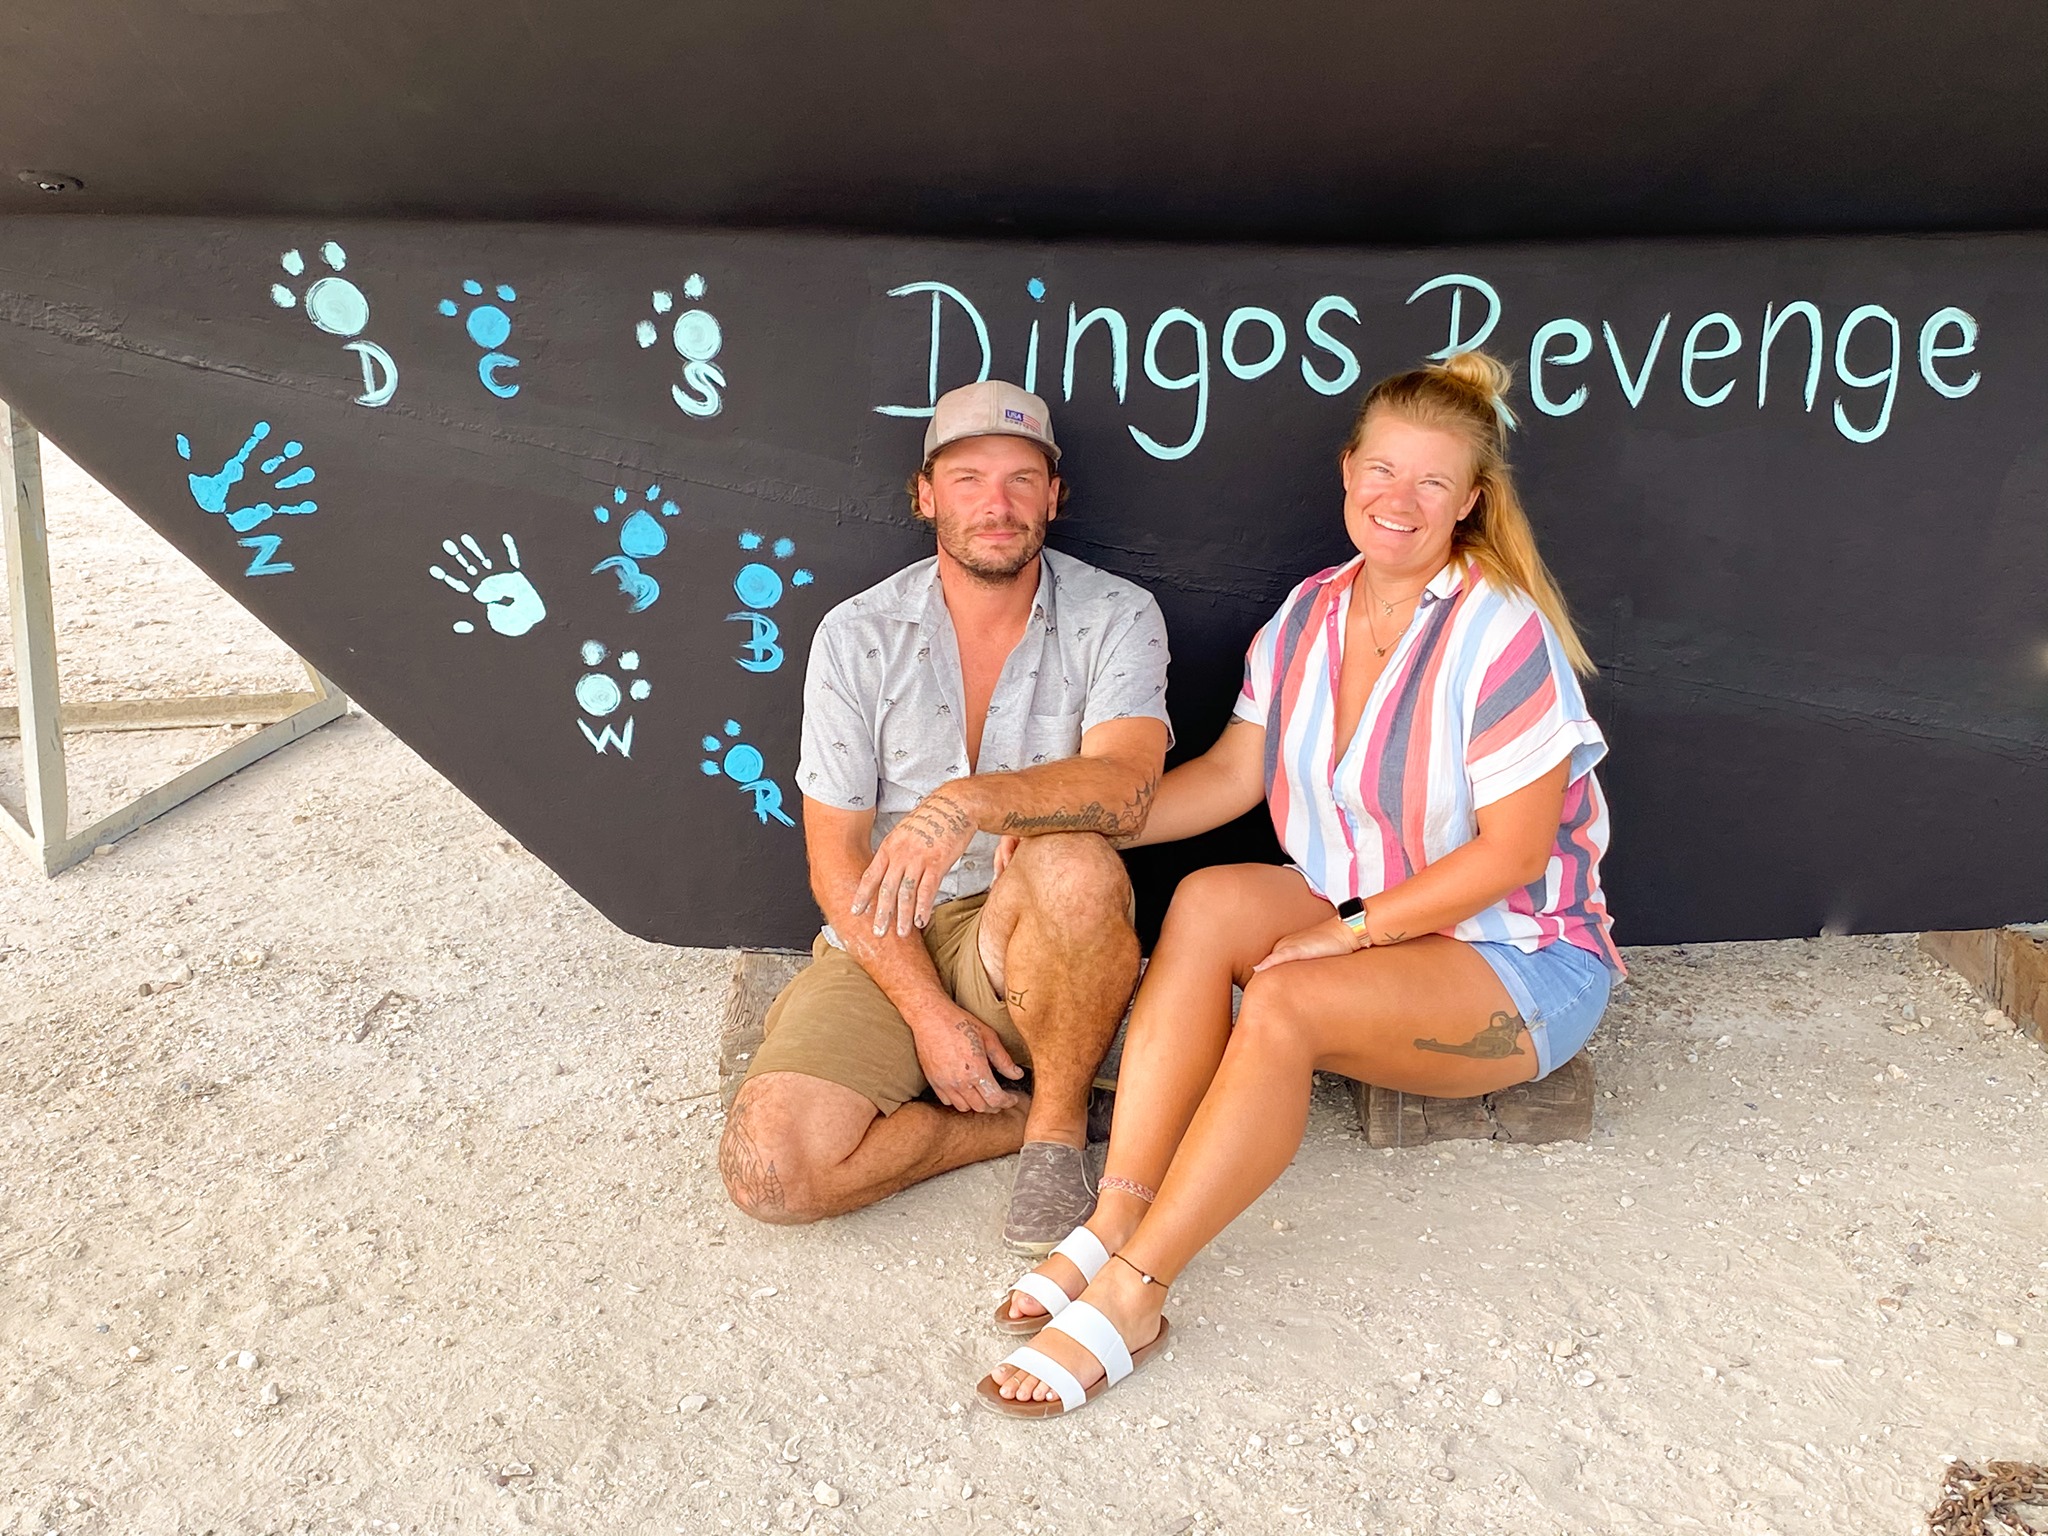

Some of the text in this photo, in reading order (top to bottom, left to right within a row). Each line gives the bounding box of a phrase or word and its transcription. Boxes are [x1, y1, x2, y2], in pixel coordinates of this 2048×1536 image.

[343, 340, 398, 407] D
[478, 351, 520, 398] C
[671, 361, 727, 417] S
[873, 273, 1982, 460] Dingos Revenge
[1006, 410, 1022, 420] USA
[723, 611, 785, 673] B
[576, 716, 635, 758] W
[739, 779, 796, 827] R
